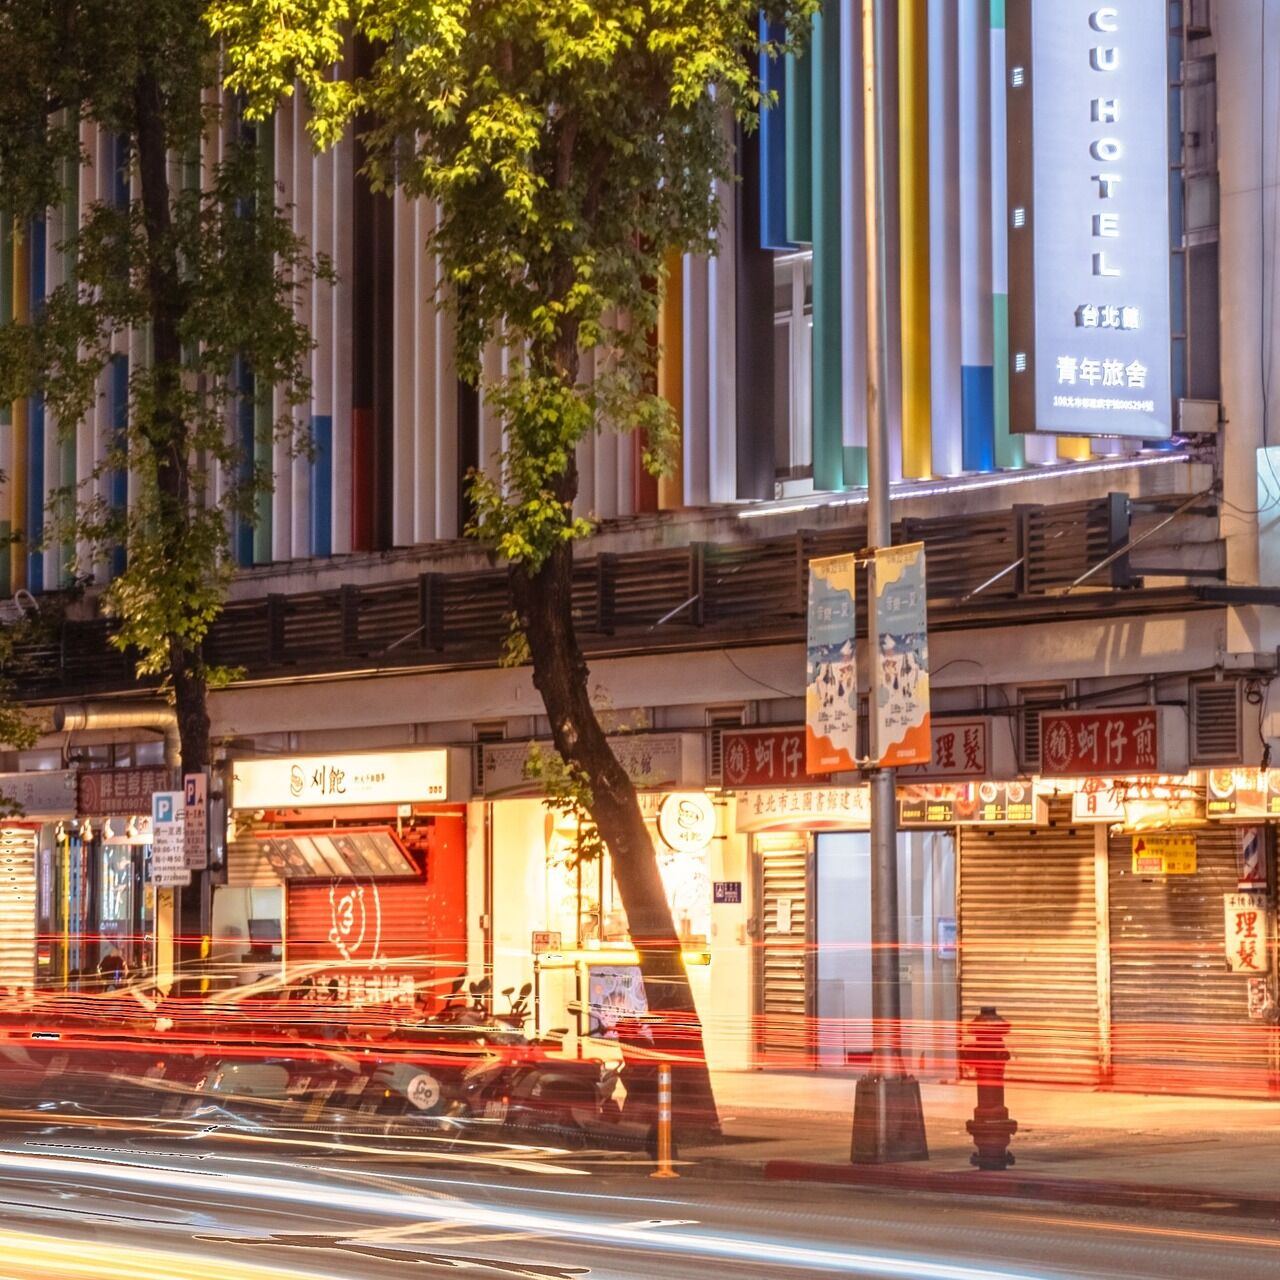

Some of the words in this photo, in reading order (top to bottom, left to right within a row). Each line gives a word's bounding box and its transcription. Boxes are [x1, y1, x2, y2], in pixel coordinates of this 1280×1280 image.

[1093, 8, 1119, 70] CU
[1096, 97, 1120, 277] HOTEL
[1056, 355, 1147, 388] 青年旅舍
[754, 736, 803, 778] 蚵仔
[915, 728, 982, 771] 理髮
[1077, 718, 1154, 765] 蚵仔煎
[158, 800, 169, 819] P
[188, 783, 194, 802] P
[1236, 912, 1259, 969] 理髮
